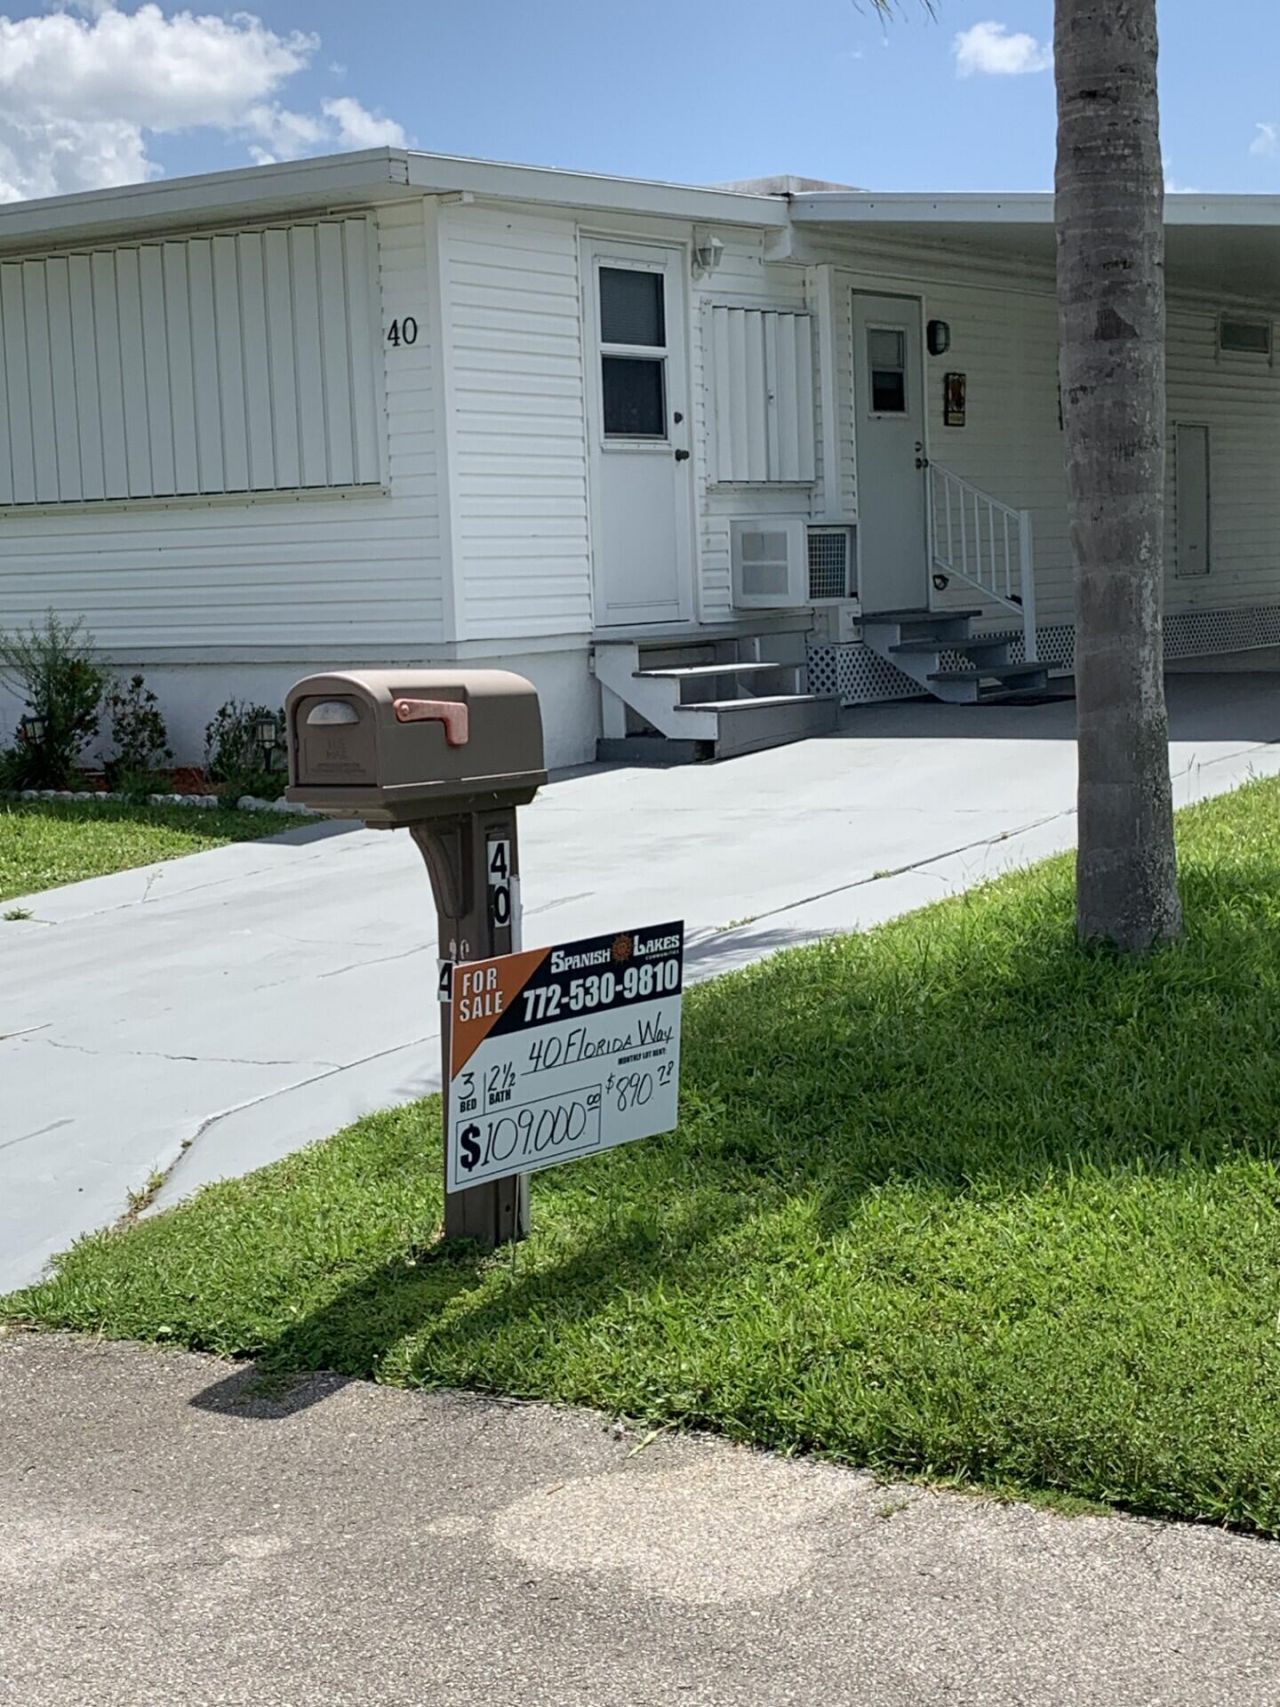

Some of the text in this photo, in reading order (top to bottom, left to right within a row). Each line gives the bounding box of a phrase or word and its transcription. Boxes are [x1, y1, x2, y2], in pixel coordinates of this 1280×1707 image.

[387, 317, 417, 347] 40
[489, 842, 511, 924] 40
[550, 934, 680, 973] SPANISH LAKES
[462, 968, 497, 996] FOR
[522, 960, 679, 1022] 772-530-9810
[459, 991, 503, 1022] SALE
[528, 1036, 562, 1073] 40
[458, 1071, 475, 1101] 3
[489, 1089, 512, 1105] BATH
[459, 1096, 477, 1113] BED
